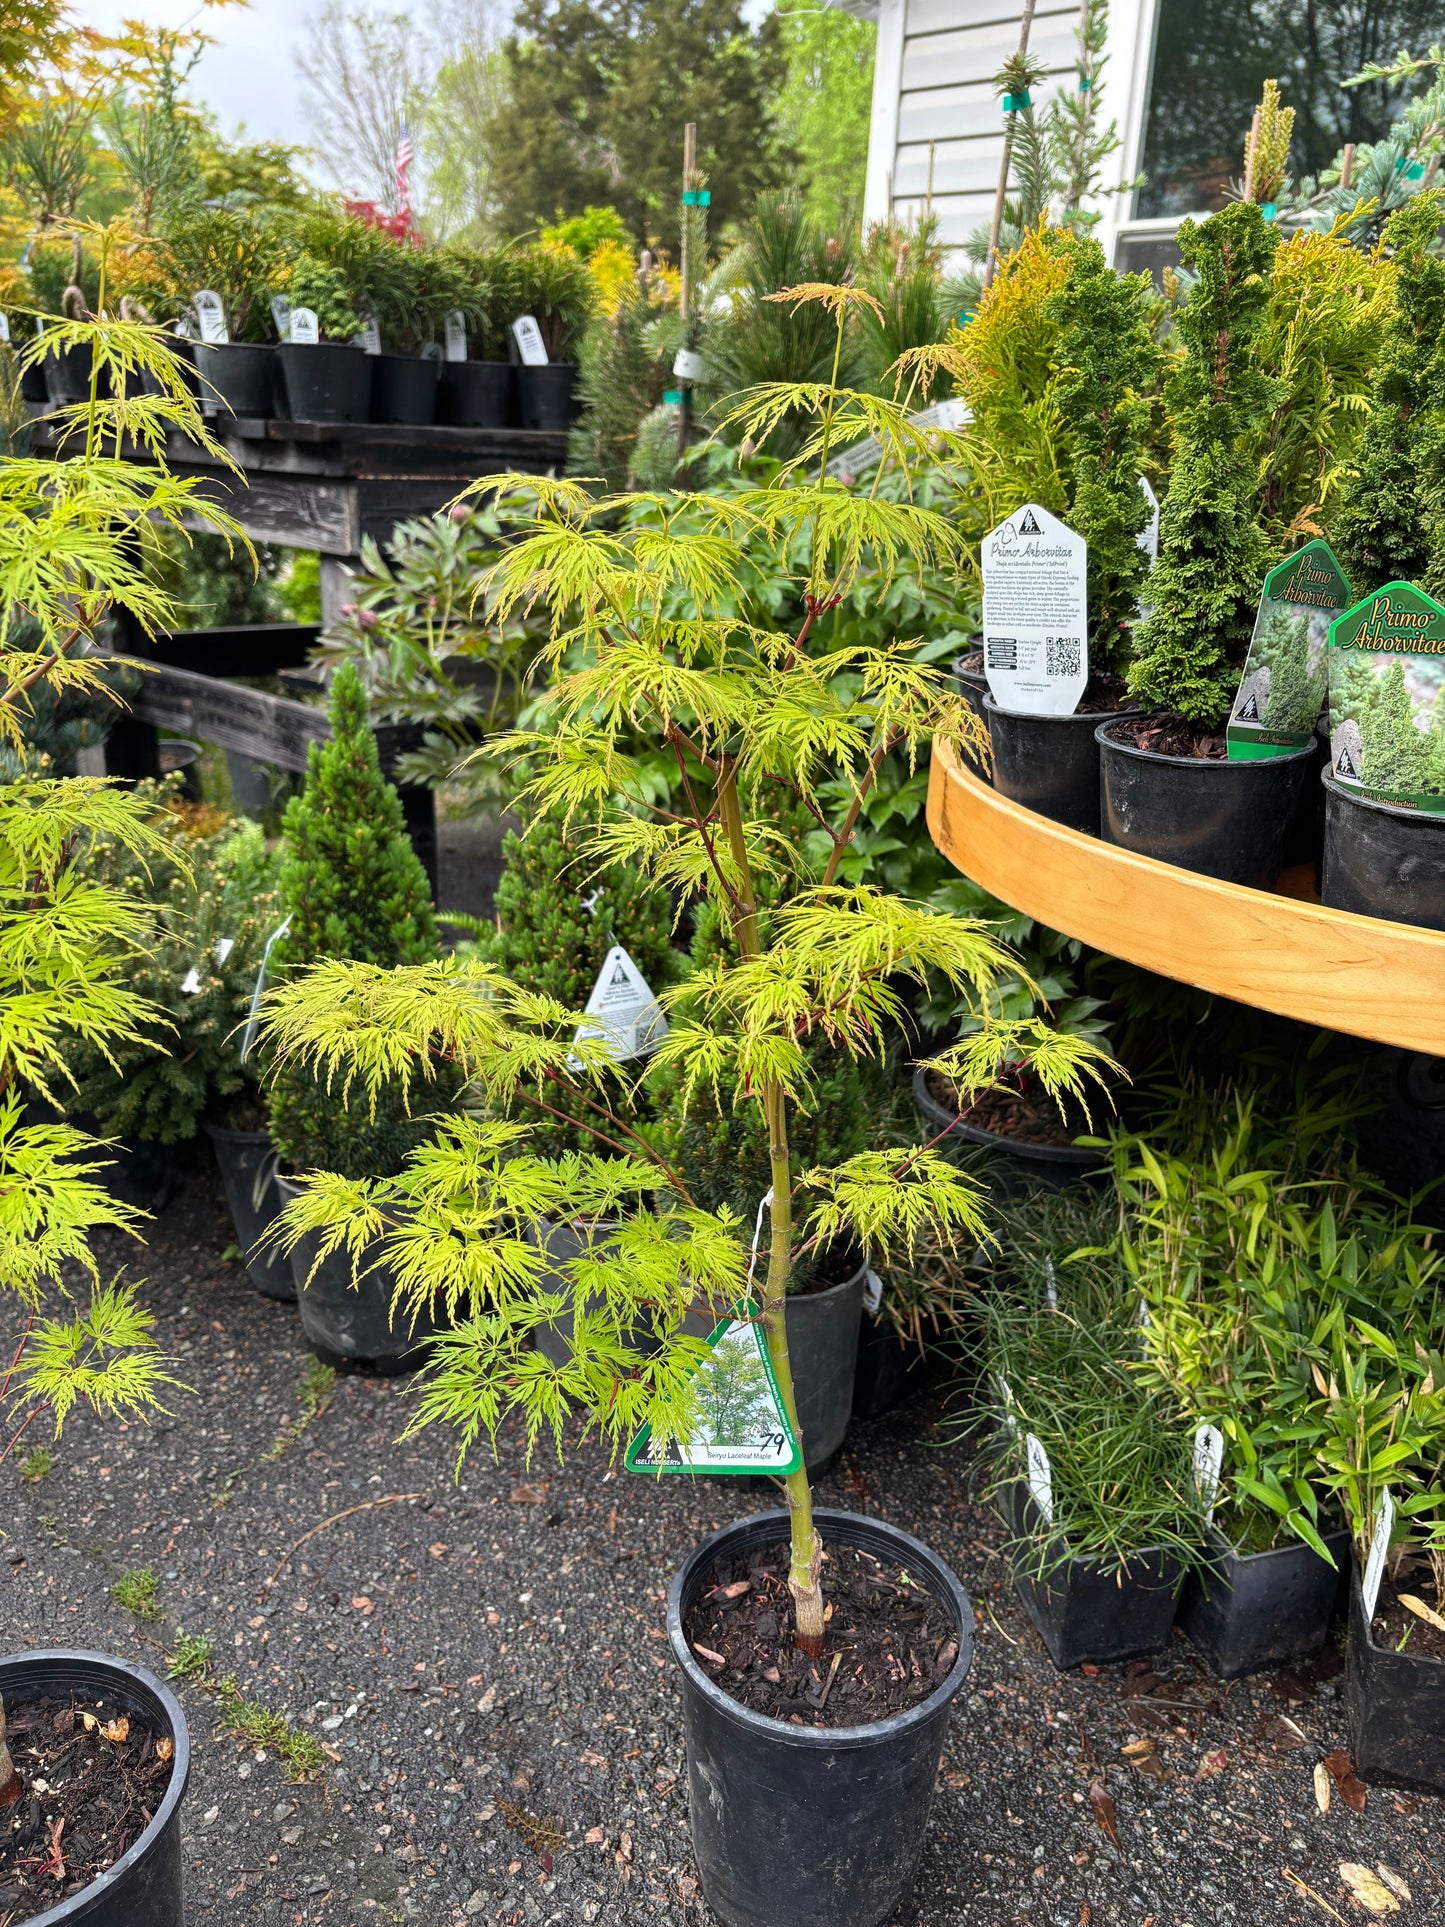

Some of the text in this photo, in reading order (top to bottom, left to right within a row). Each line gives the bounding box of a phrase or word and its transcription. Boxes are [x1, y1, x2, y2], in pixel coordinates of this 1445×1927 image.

[995, 522, 1018, 545] 29
[1020, 541, 1073, 558] Arborvitae
[1273, 575, 1337, 608] Arborvitae
[759, 1433, 785, 1456] 79
